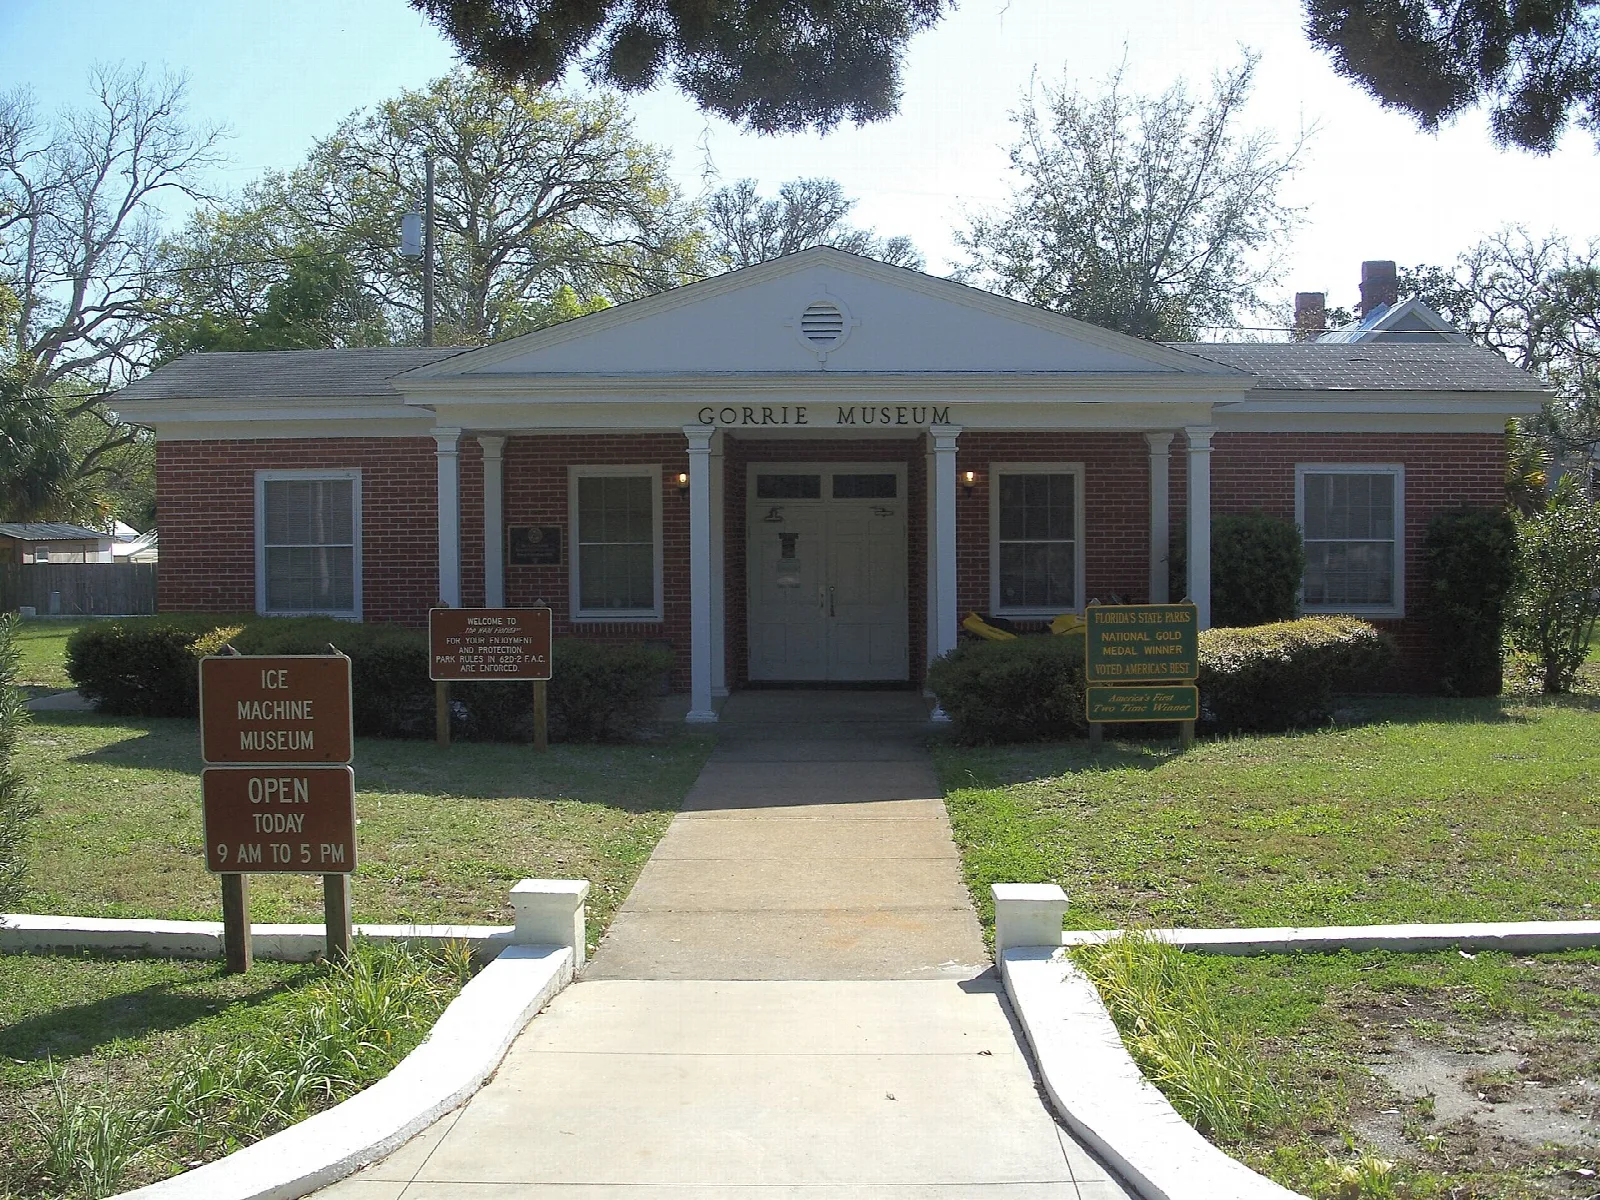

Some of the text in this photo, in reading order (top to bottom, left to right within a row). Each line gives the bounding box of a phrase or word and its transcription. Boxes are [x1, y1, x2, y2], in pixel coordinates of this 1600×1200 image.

[698, 406, 951, 425] GORRIE MUSEUM
[467, 617, 517, 625] WELCOME TO
[1095, 611, 1191, 624] FLORIDA'S STATE PARKS
[446, 637, 461, 645] FOR
[1101, 631, 1182, 641] NATIONAL GOLD
[458, 646, 524, 654] AND PROTECTION.
[1103, 645, 1183, 655] MEDAL WINNER
[435, 655, 456, 663] PARK
[460, 655, 484, 663] RULES
[487, 655, 496, 663] IN
[499, 655, 522, 663] 62D-2
[480, 664, 520, 672] ENFORCED.
[1095, 662, 1190, 675] VOTED AMERICA'S BEST
[261, 669, 288, 689] ICE
[1109, 693, 1175, 702] America's First
[237, 701, 314, 720] MACHINE
[1093, 704, 1191, 713] Two Time Winner
[240, 730, 314, 750] MUSEUM
[248, 777, 309, 804] OPEN
[252, 813, 305, 833] TODAY
[217, 843, 345, 863] 9 AM TO 5 PM
